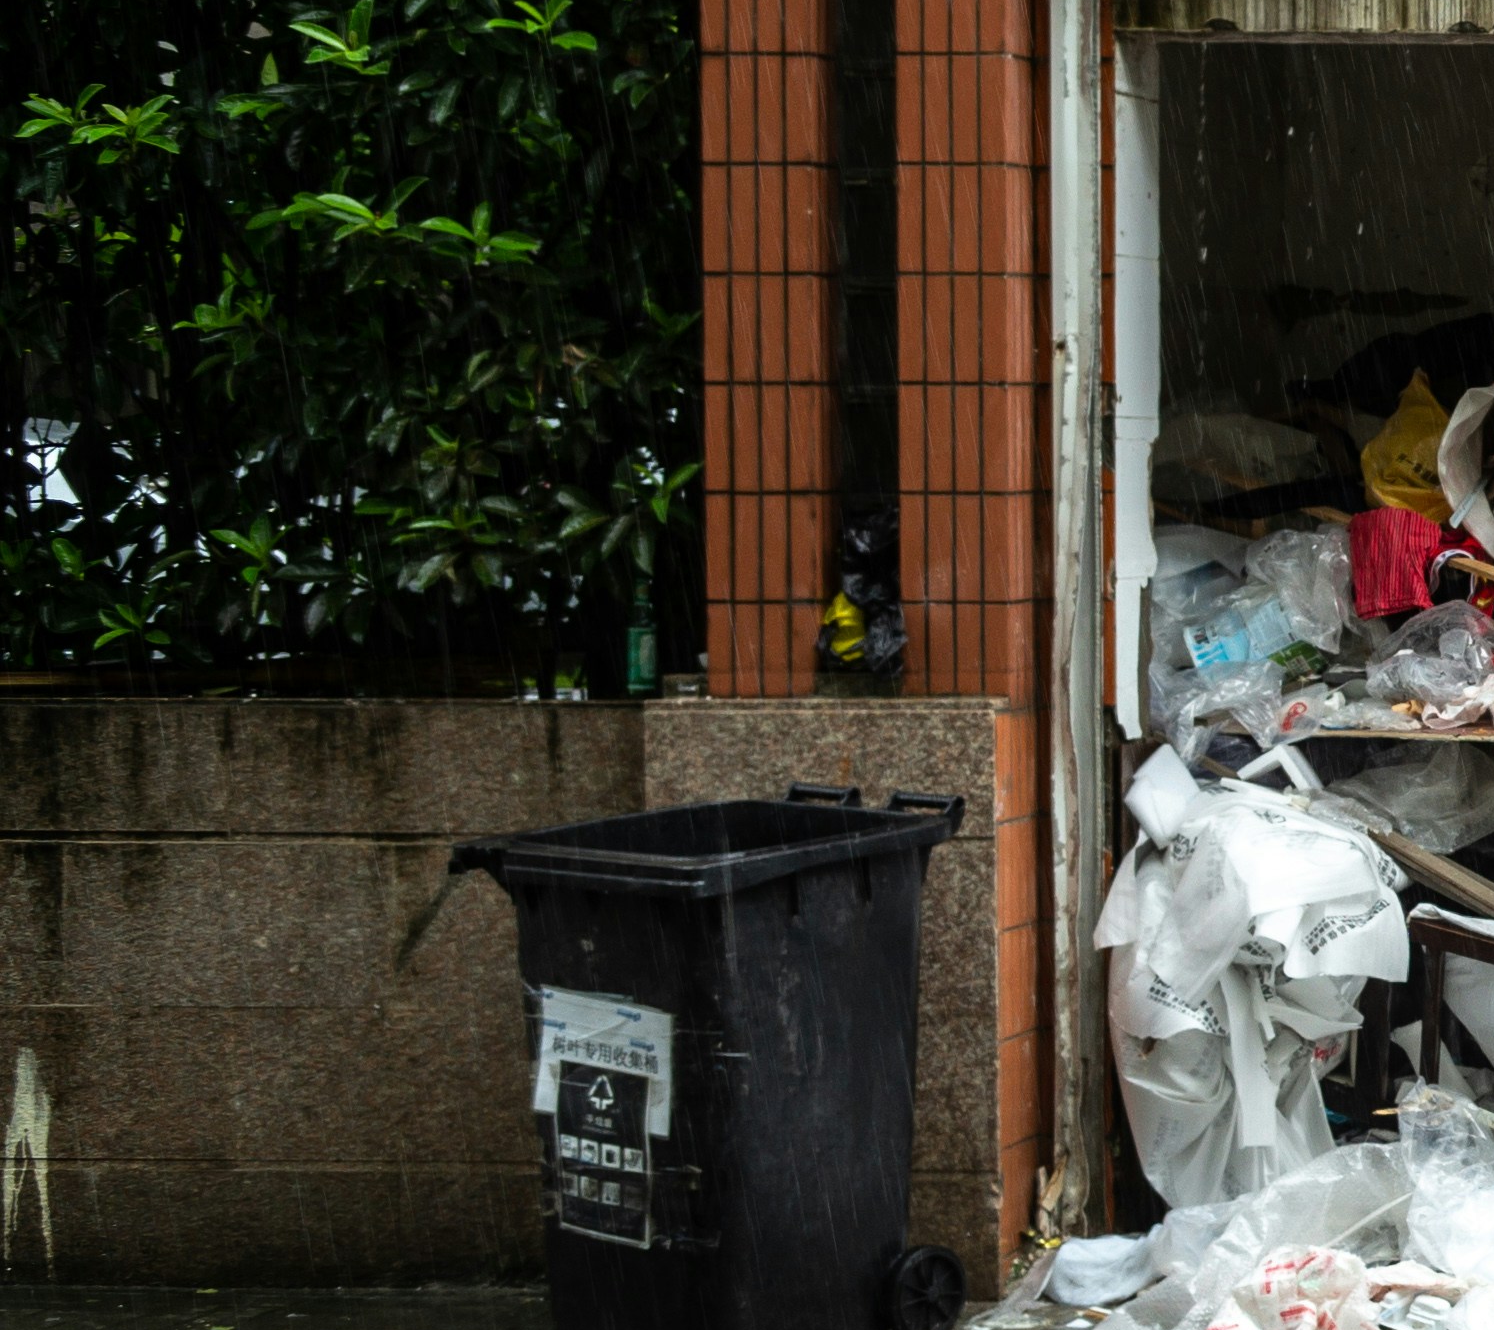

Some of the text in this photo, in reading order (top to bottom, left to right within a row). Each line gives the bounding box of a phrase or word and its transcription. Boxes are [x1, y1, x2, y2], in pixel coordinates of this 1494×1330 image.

[552, 1034, 660, 1076] 树叶专用收集桶
